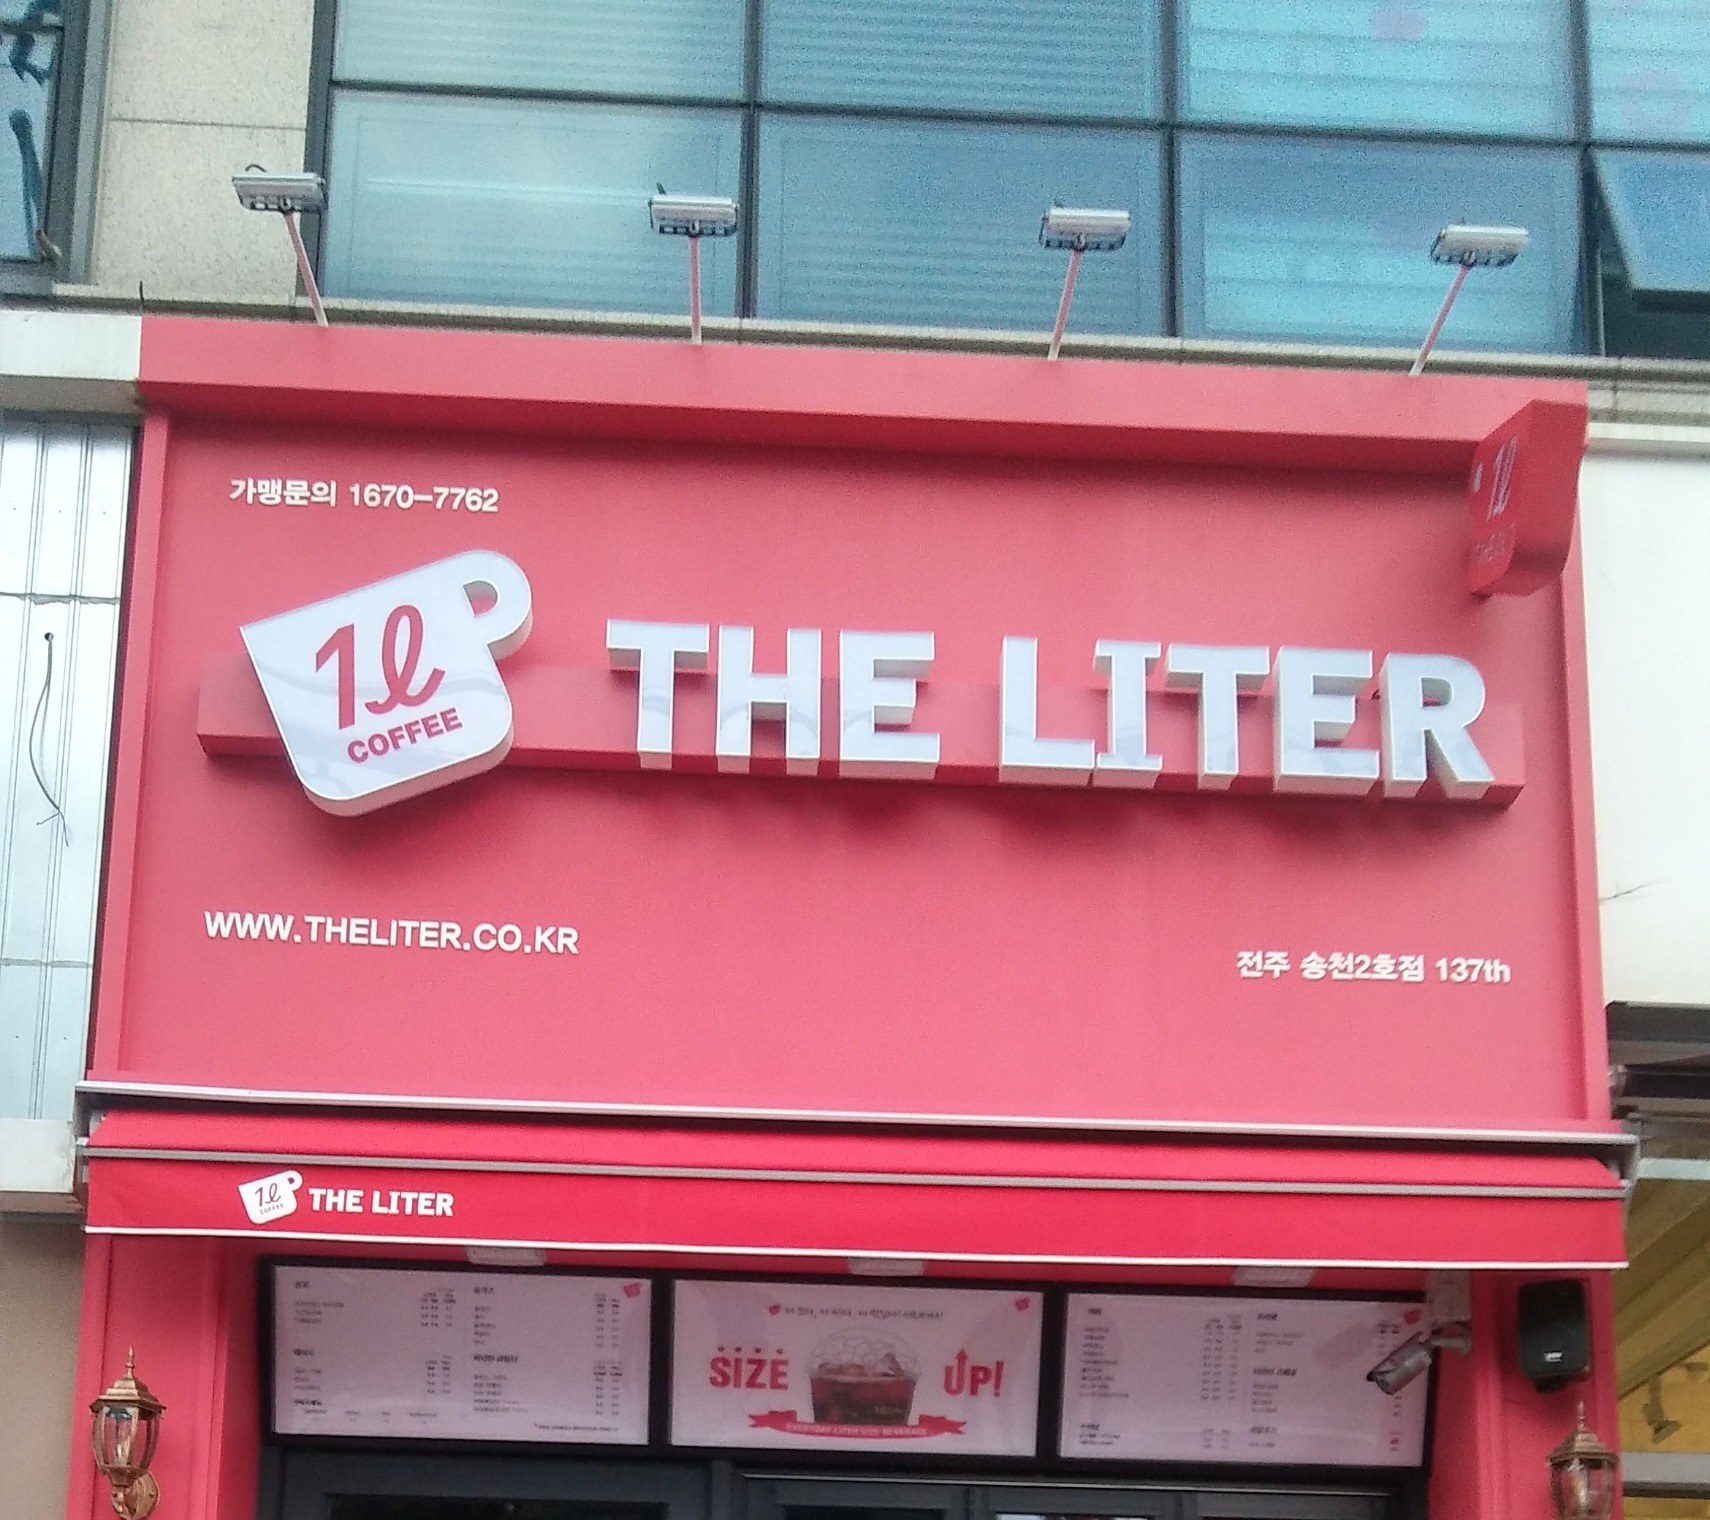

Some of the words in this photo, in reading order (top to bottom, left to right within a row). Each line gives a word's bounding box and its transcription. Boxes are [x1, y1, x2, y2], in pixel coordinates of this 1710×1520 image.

[229, 478, 338, 508] 가맹문의
[349, 482, 499, 513] 1670-7762
[606, 618, 940, 772] THE
[1001, 636, 1496, 790] LITER
[347, 707, 464, 763] COFFEE
[204, 911, 580, 955] WWW.THELITER.CO.KR
[1236, 951, 1291, 979] 전주
[1300, 951, 1426, 983] 송천2호점
[1435, 957, 1511, 984] 137th
[260, 1203, 284, 1215] COFFEE
[308, 1187, 365, 1213] THE
[371, 1190, 454, 1217] LITER
[709, 1355, 790, 1391] SIZE
[943, 1348, 1005, 1398] UP!
